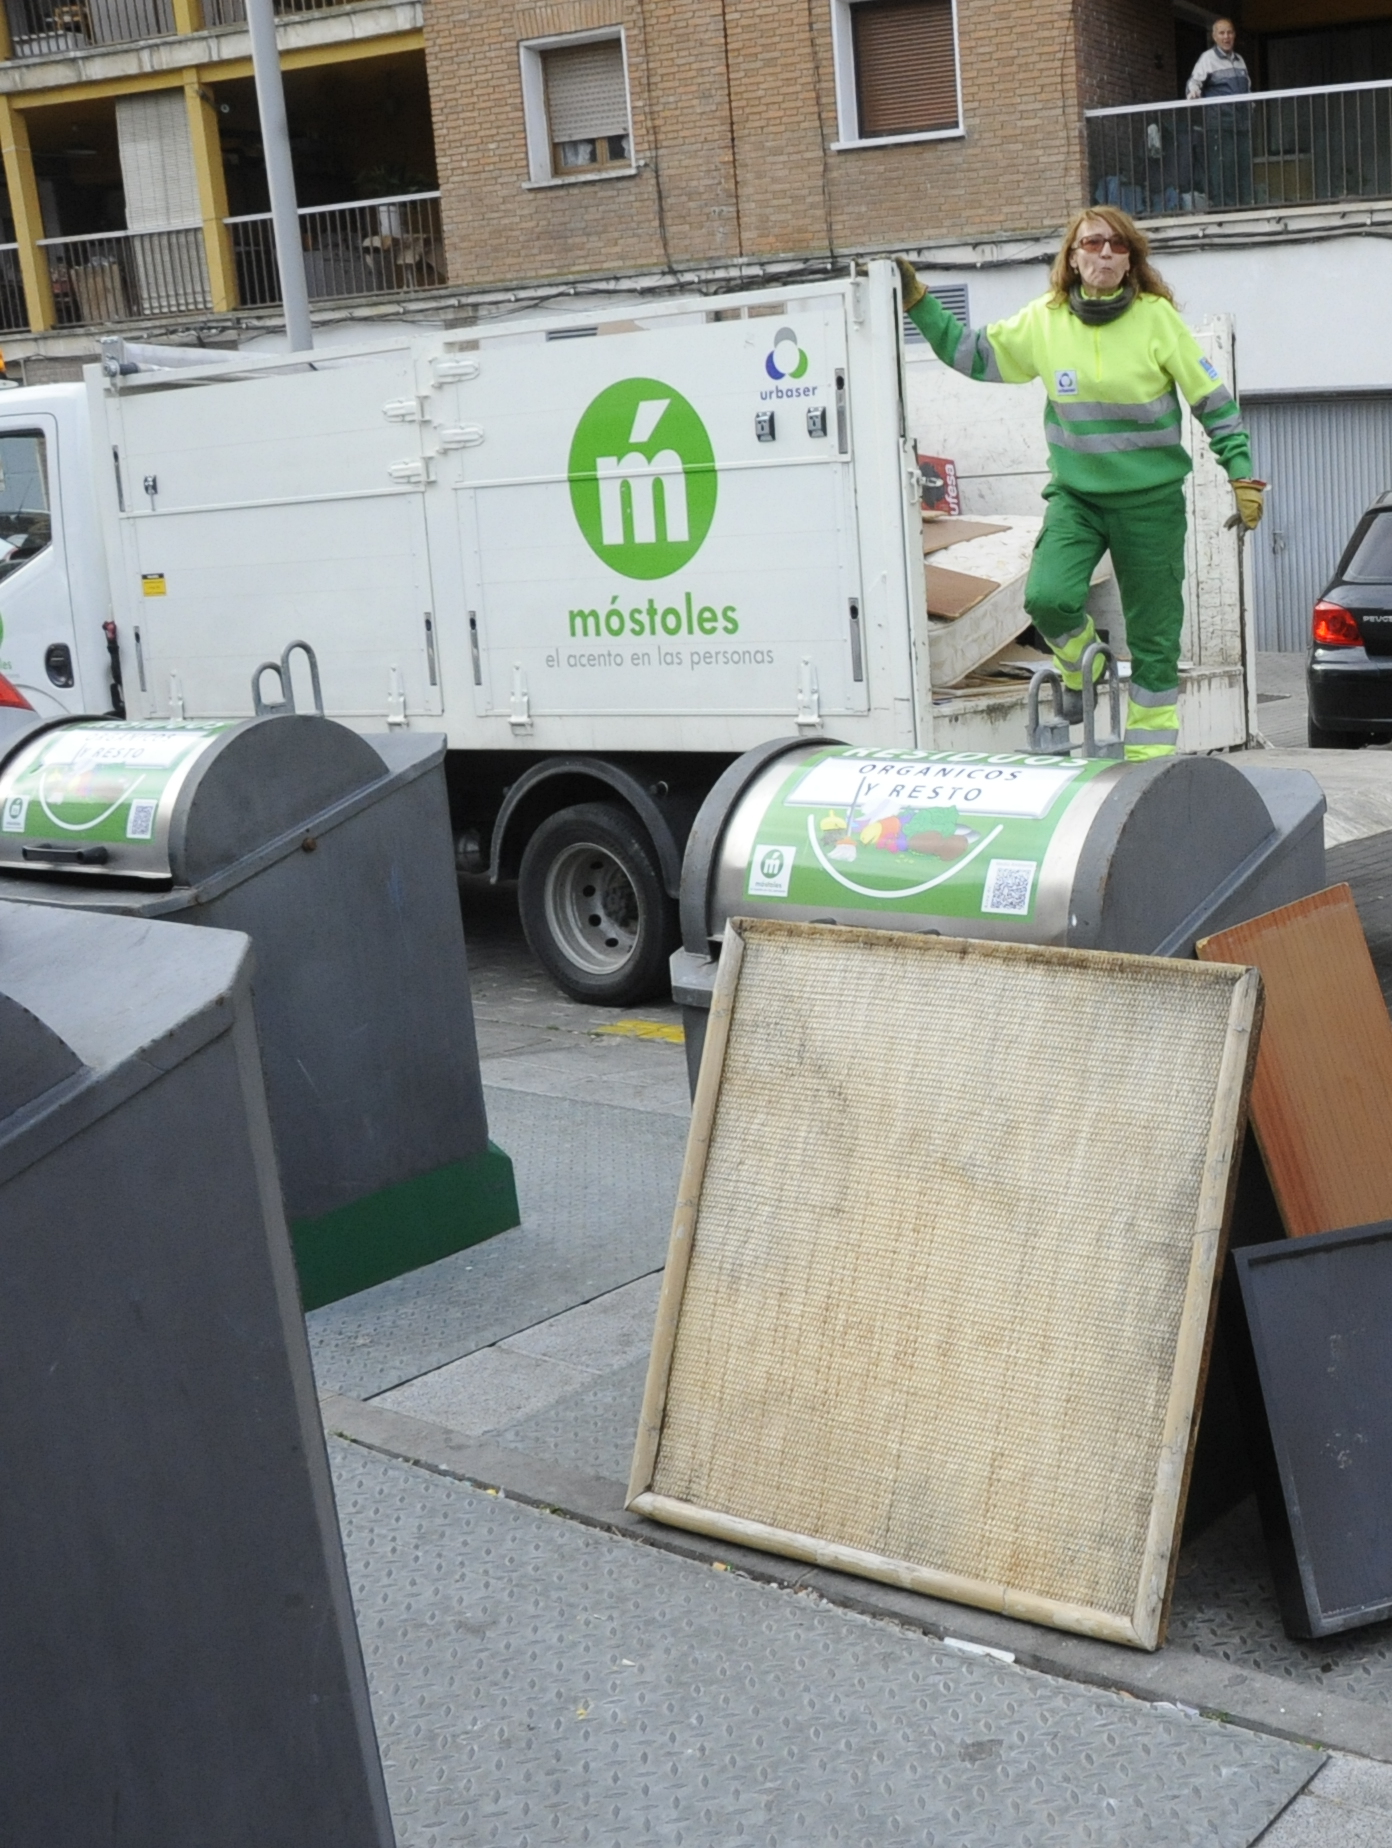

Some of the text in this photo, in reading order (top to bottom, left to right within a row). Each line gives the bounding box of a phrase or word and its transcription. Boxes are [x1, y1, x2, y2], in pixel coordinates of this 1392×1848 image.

[759, 384, 819, 401] urbaser
[945, 464, 959, 515] ufesa
[568, 591, 740, 637] móstoles
[545, 645, 774, 671] el acento en las personas
[92, 747, 145, 759] RESTO
[842, 746, 1089, 767] RESIDUOS
[863, 783, 982, 802] Y RESTO
